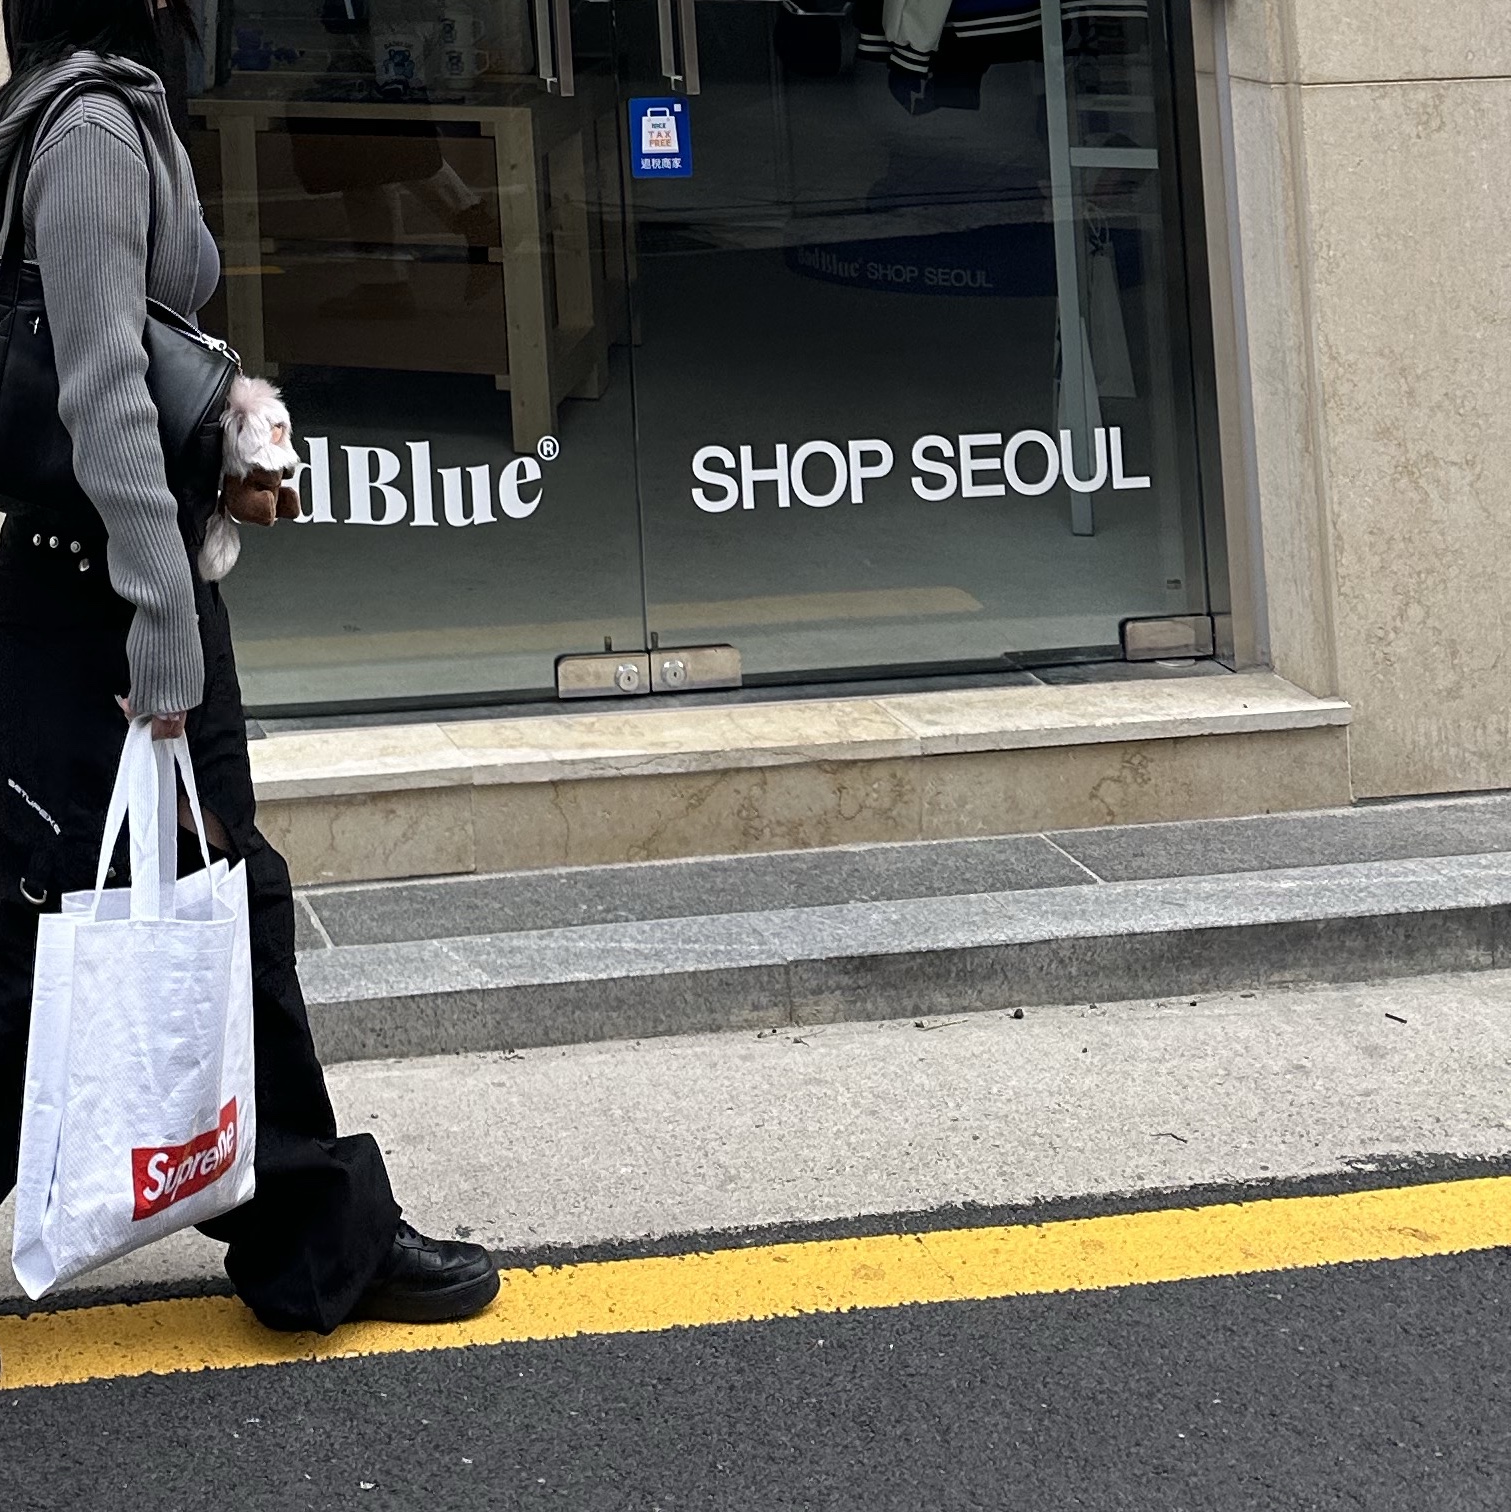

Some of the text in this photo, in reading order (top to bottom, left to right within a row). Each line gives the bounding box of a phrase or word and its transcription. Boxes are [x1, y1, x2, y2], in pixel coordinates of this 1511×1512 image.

[648, 130, 672, 138] TAX
[649, 139, 672, 147] FREE
[866, 261, 919, 284] SHOP
[924, 267, 994, 289] SEOUL
[691, 426, 1151, 514] SHOP SEOUL
